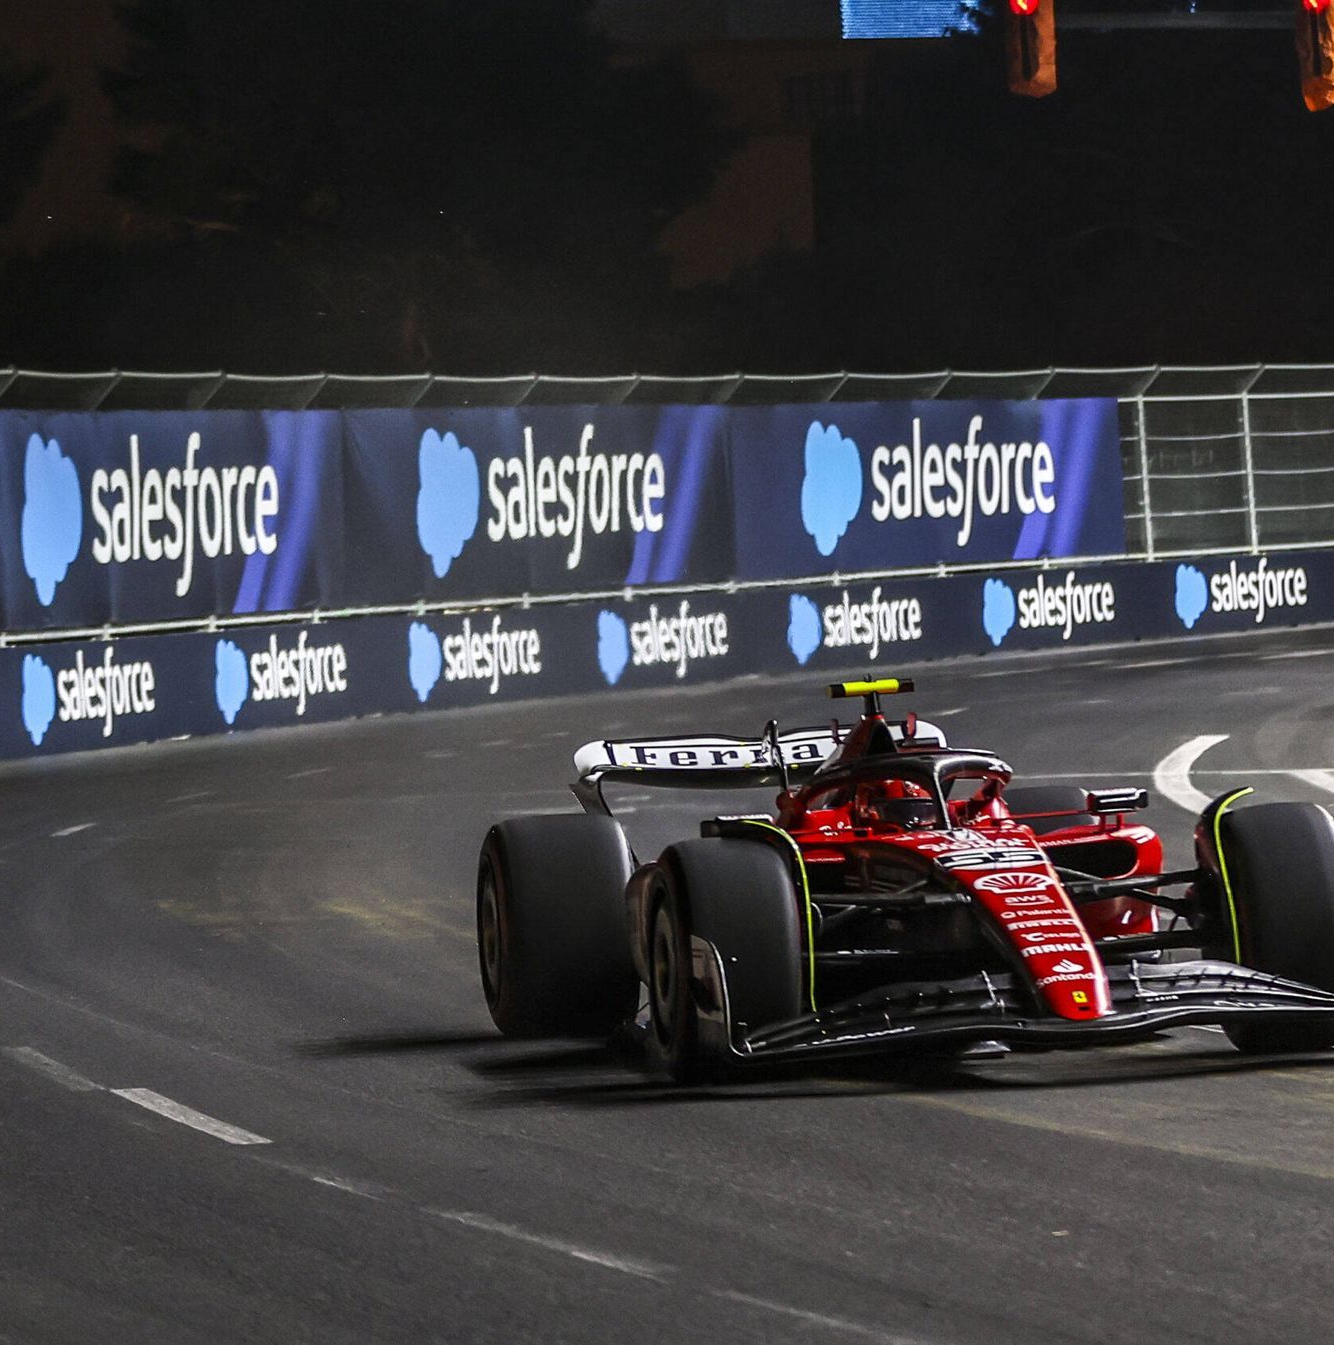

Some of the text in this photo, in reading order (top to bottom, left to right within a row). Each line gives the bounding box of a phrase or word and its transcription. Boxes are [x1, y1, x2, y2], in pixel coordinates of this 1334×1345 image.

[91, 431, 280, 597] salesforce
[487, 422, 666, 570] salesforce
[871, 414, 1056, 547] salesforce
[821, 586, 923, 660] salesforce
[1017, 570, 1115, 640] salesforce
[1210, 556, 1308, 624] salesforce
[249, 630, 348, 716] salesforce
[441, 614, 542, 695] salesforce
[629, 599, 730, 679] salesforce
[57, 645, 156, 738] salesforce
[1005, 894, 1053, 904] aws
